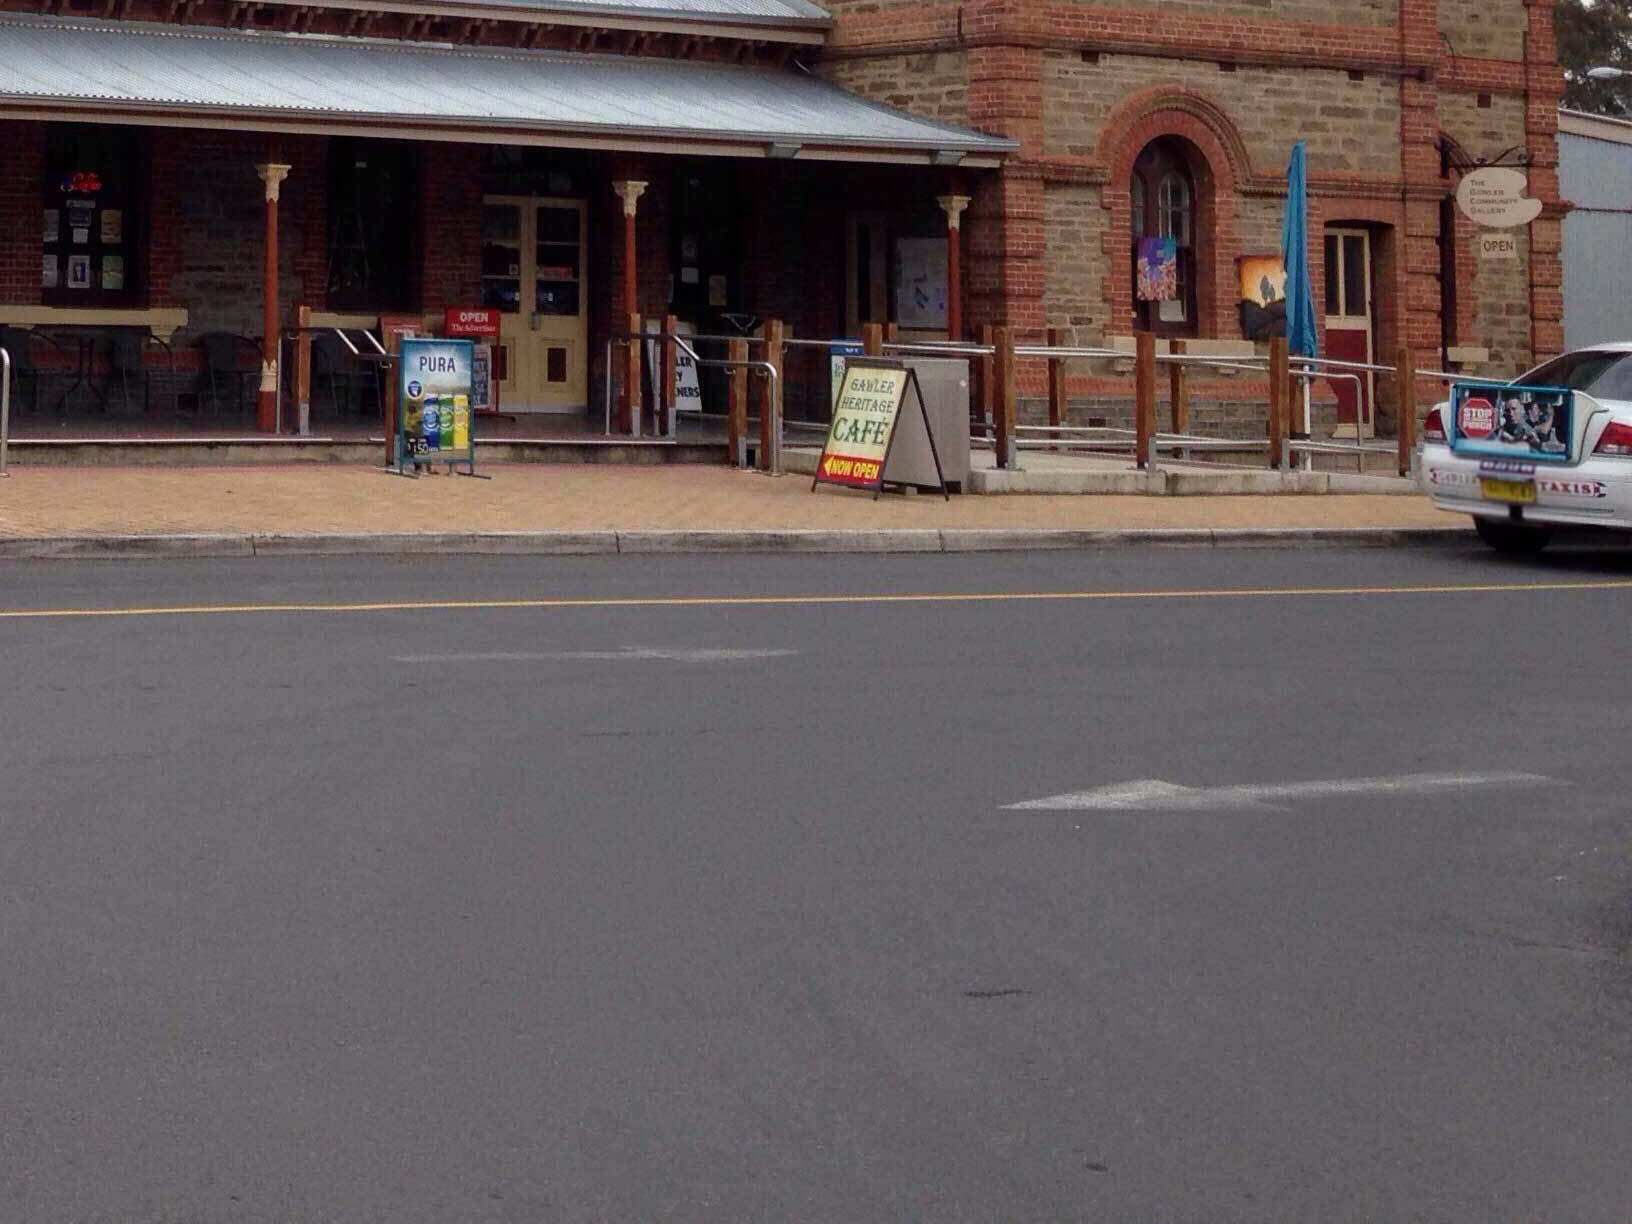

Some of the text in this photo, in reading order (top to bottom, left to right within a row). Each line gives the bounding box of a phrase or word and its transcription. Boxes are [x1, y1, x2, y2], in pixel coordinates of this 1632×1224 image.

[1483, 240, 1514, 252] OPEN
[459, 312, 489, 323] OPEN
[419, 356, 456, 373] PURA
[850, 378, 895, 394] GAWLER
[842, 396, 895, 413] HERITAGE
[1463, 407, 1493, 418] STOP
[833, 417, 889, 446] CAFÉ
[830, 458, 880, 480] NOW OPEN
[1540, 480, 1592, 496] TAXIS
